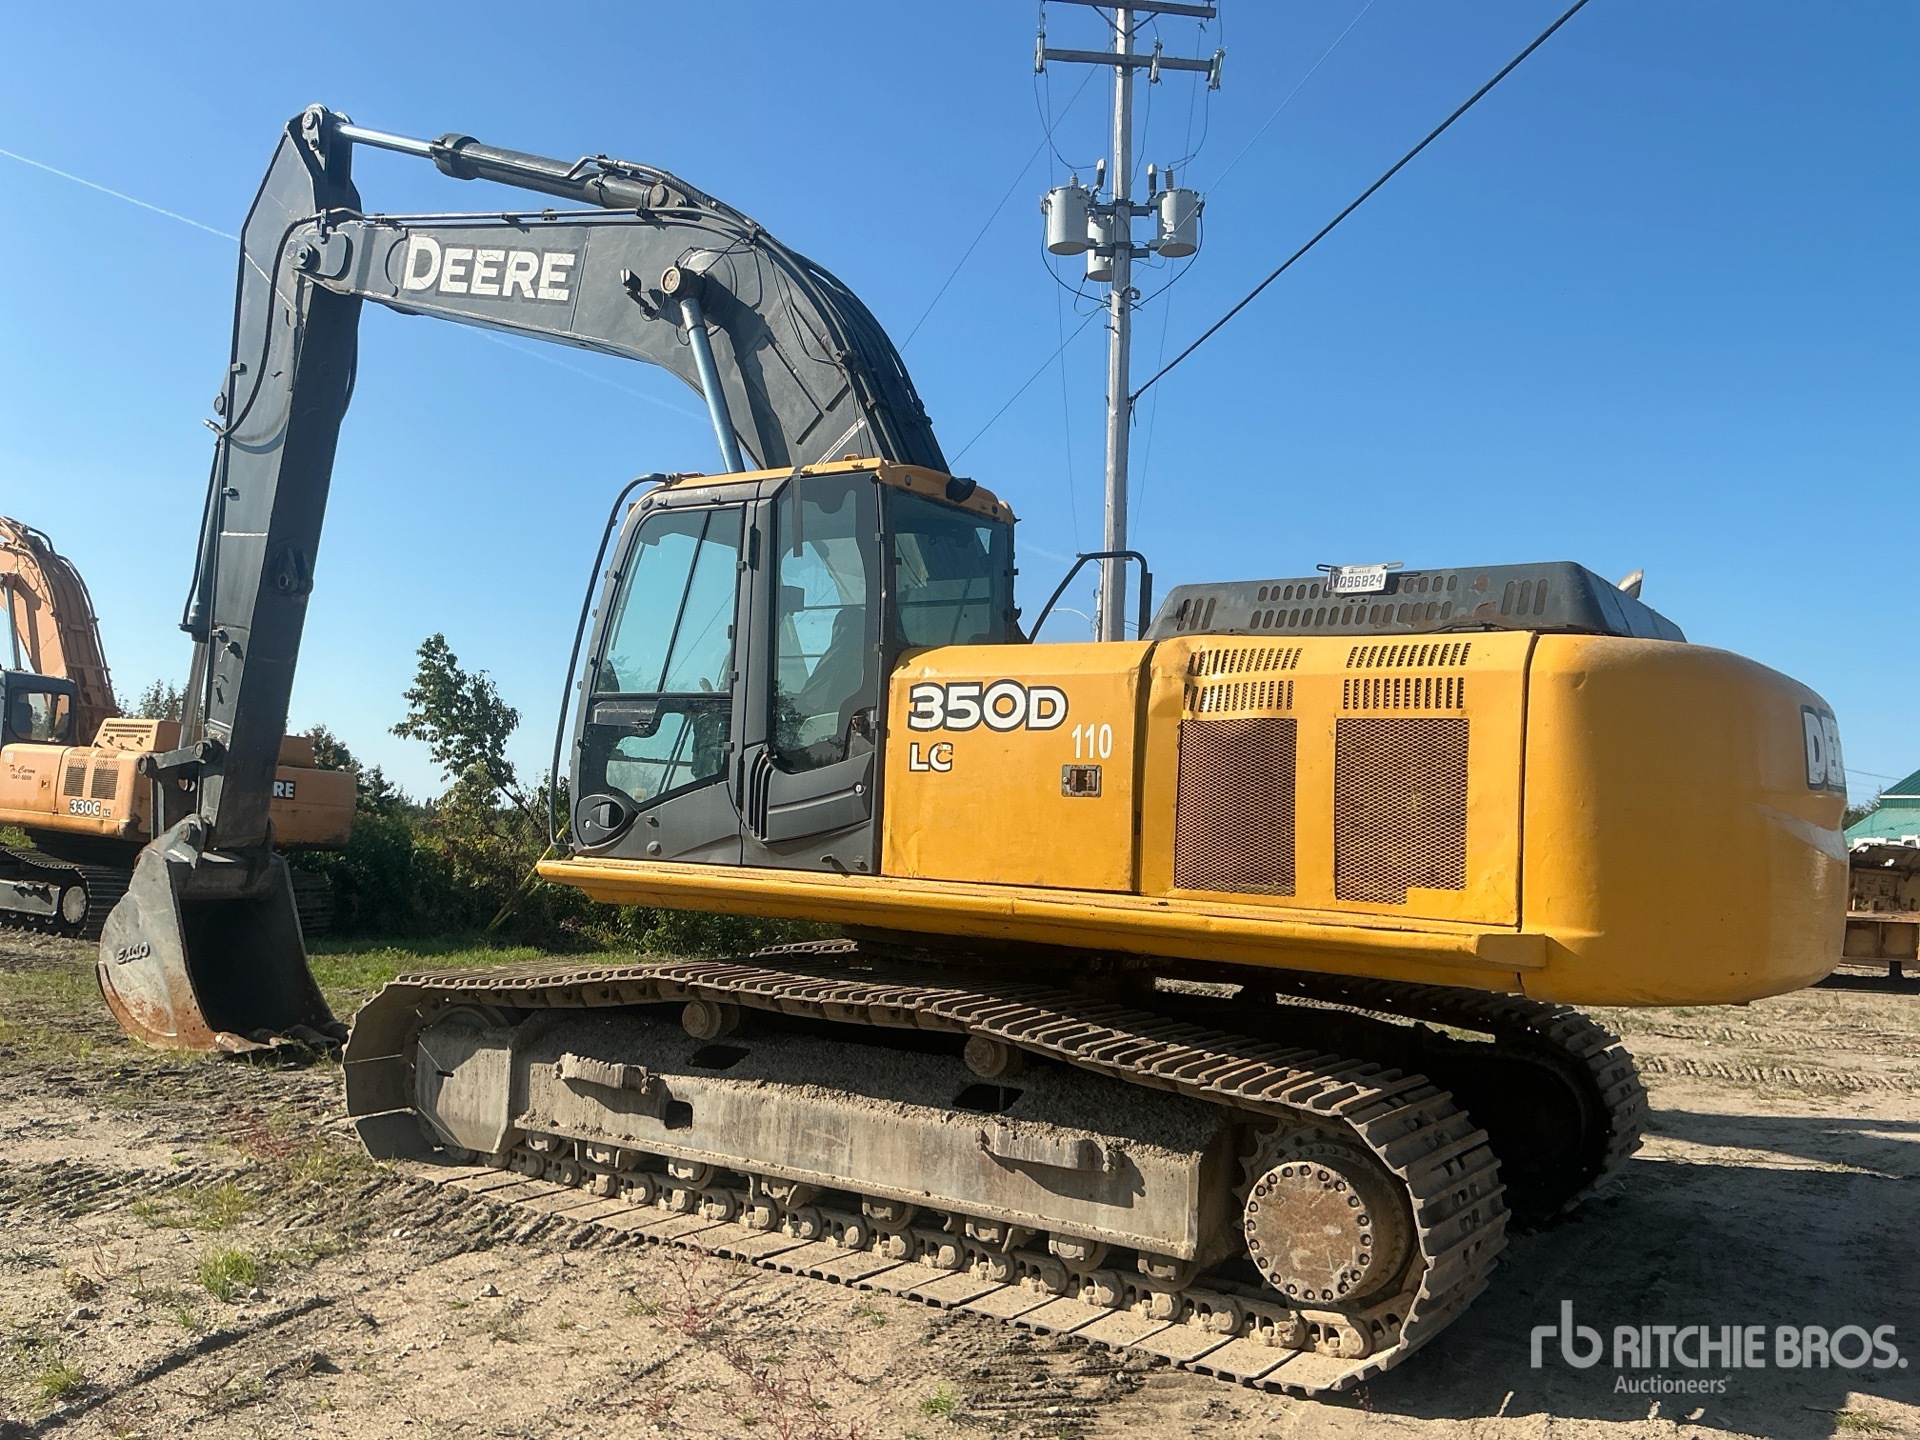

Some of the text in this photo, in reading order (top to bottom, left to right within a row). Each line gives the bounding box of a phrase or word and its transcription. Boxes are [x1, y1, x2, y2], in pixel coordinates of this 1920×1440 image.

[403, 234, 575, 301] DEERE
[908, 679, 1069, 732] 350D
[909, 742, 954, 772] LC
[1071, 723, 1113, 760] 110
[69, 798, 111, 817] 330C LC
